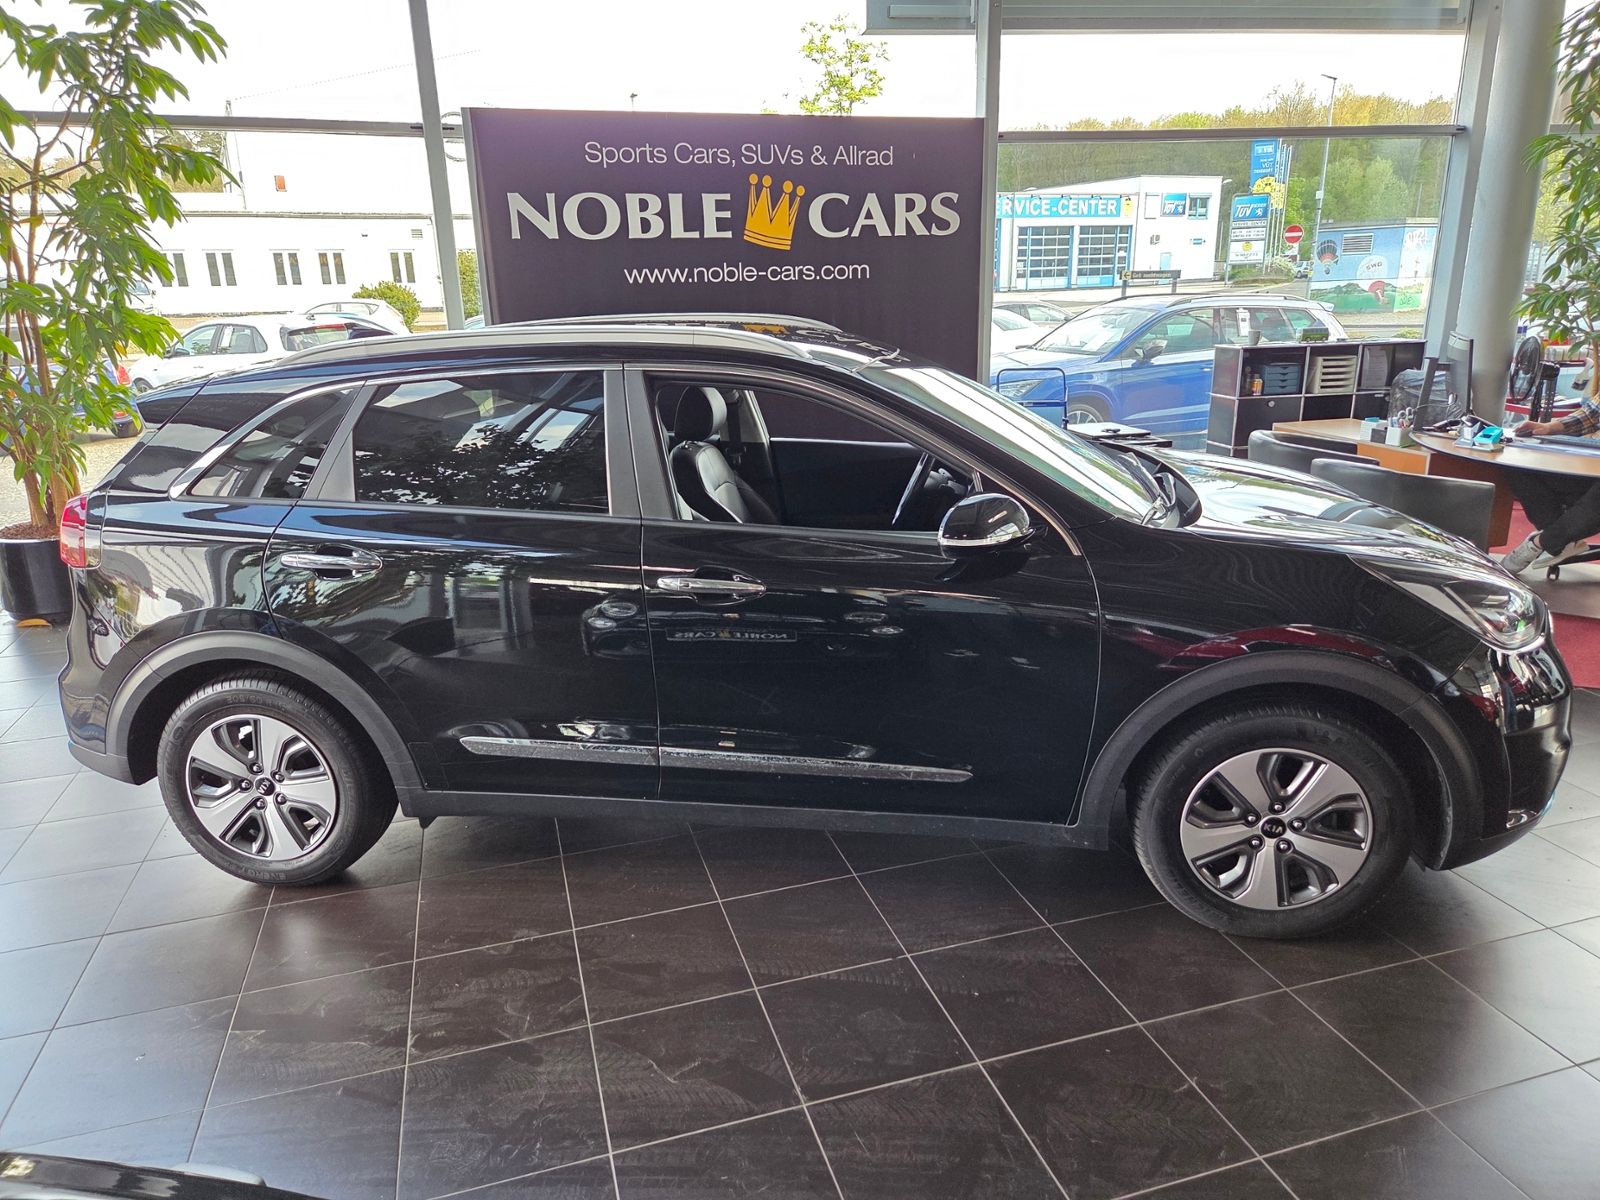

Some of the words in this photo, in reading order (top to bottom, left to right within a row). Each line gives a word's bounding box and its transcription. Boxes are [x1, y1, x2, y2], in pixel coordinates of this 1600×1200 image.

[584, 141, 668, 168] Sports
[673, 142, 736, 168] Cars,
[741, 143, 804, 165] SUVs
[810, 145, 828, 166] &
[833, 145, 894, 166] Allrad
[506, 191, 733, 240] NOBLE
[808, 191, 961, 239] CARS
[624, 262, 870, 284] www.noble-cars.com
[257, 779, 271, 794] KIA
[1263, 823, 1283, 833] KIA
